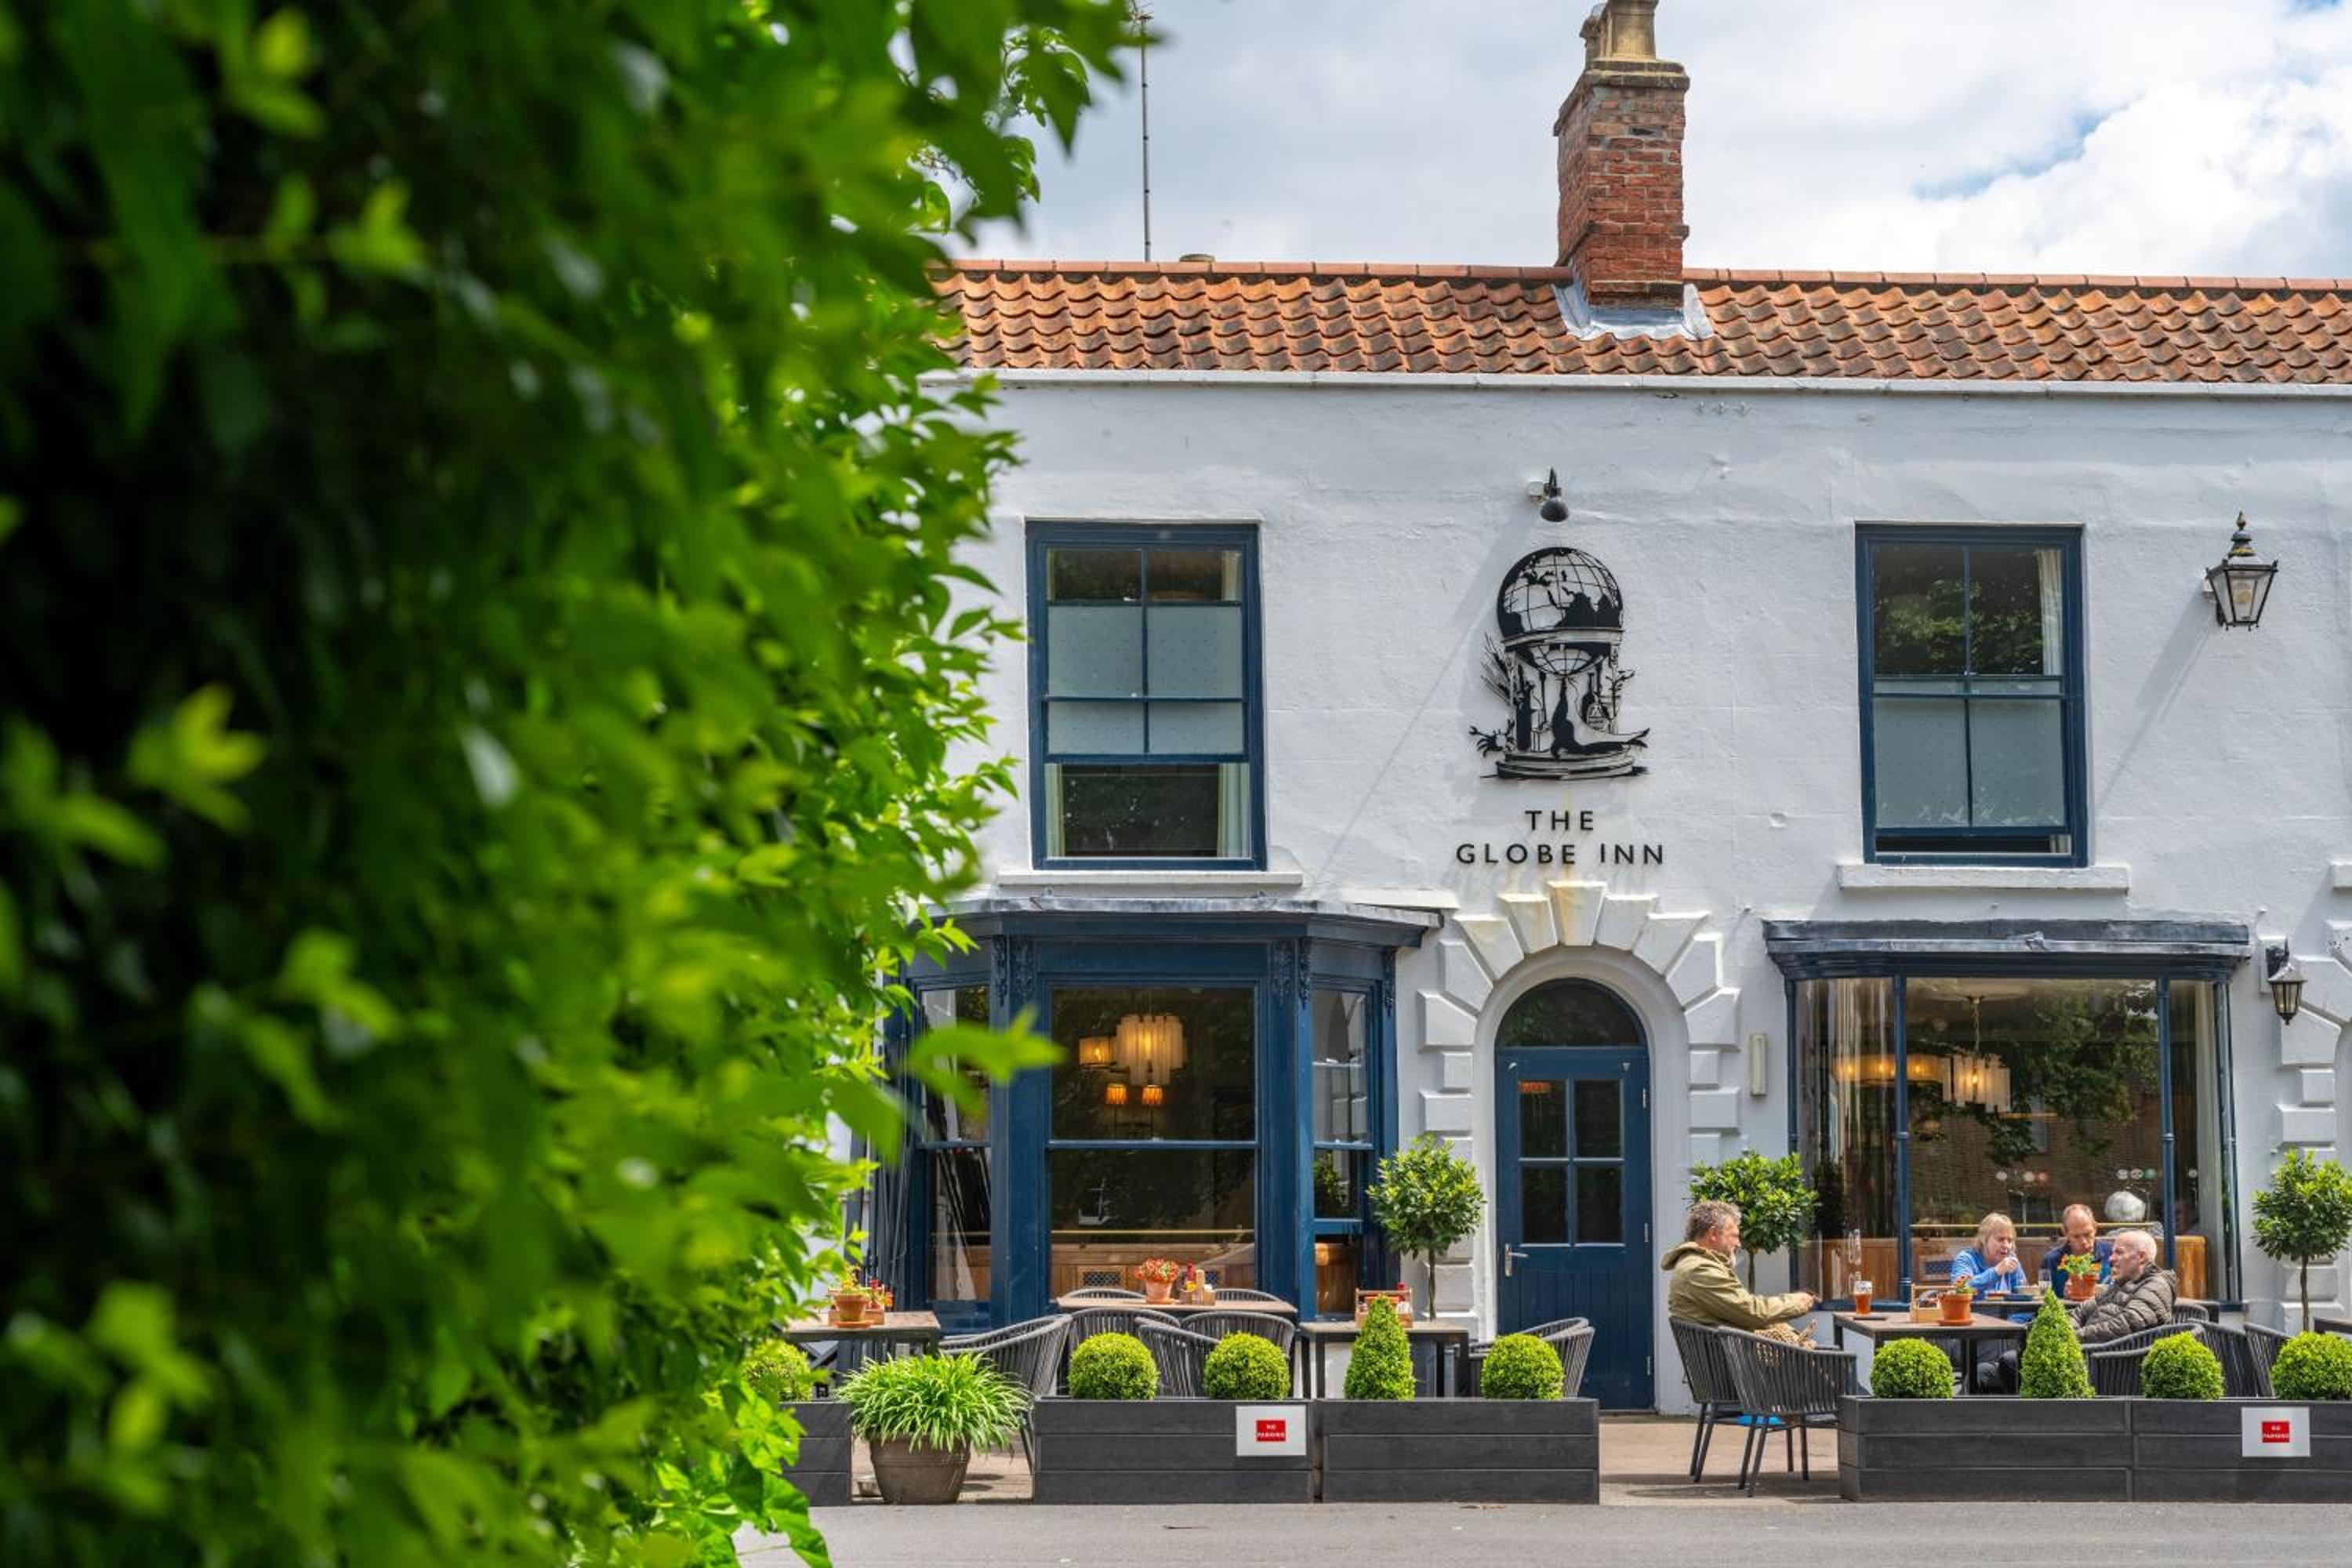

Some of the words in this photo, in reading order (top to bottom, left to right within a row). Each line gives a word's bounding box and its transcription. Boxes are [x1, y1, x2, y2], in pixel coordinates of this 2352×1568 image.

[1525, 810, 1594, 831] THE
[1456, 844, 1575, 865] GLOBE
[1600, 844, 1663, 864] INN
